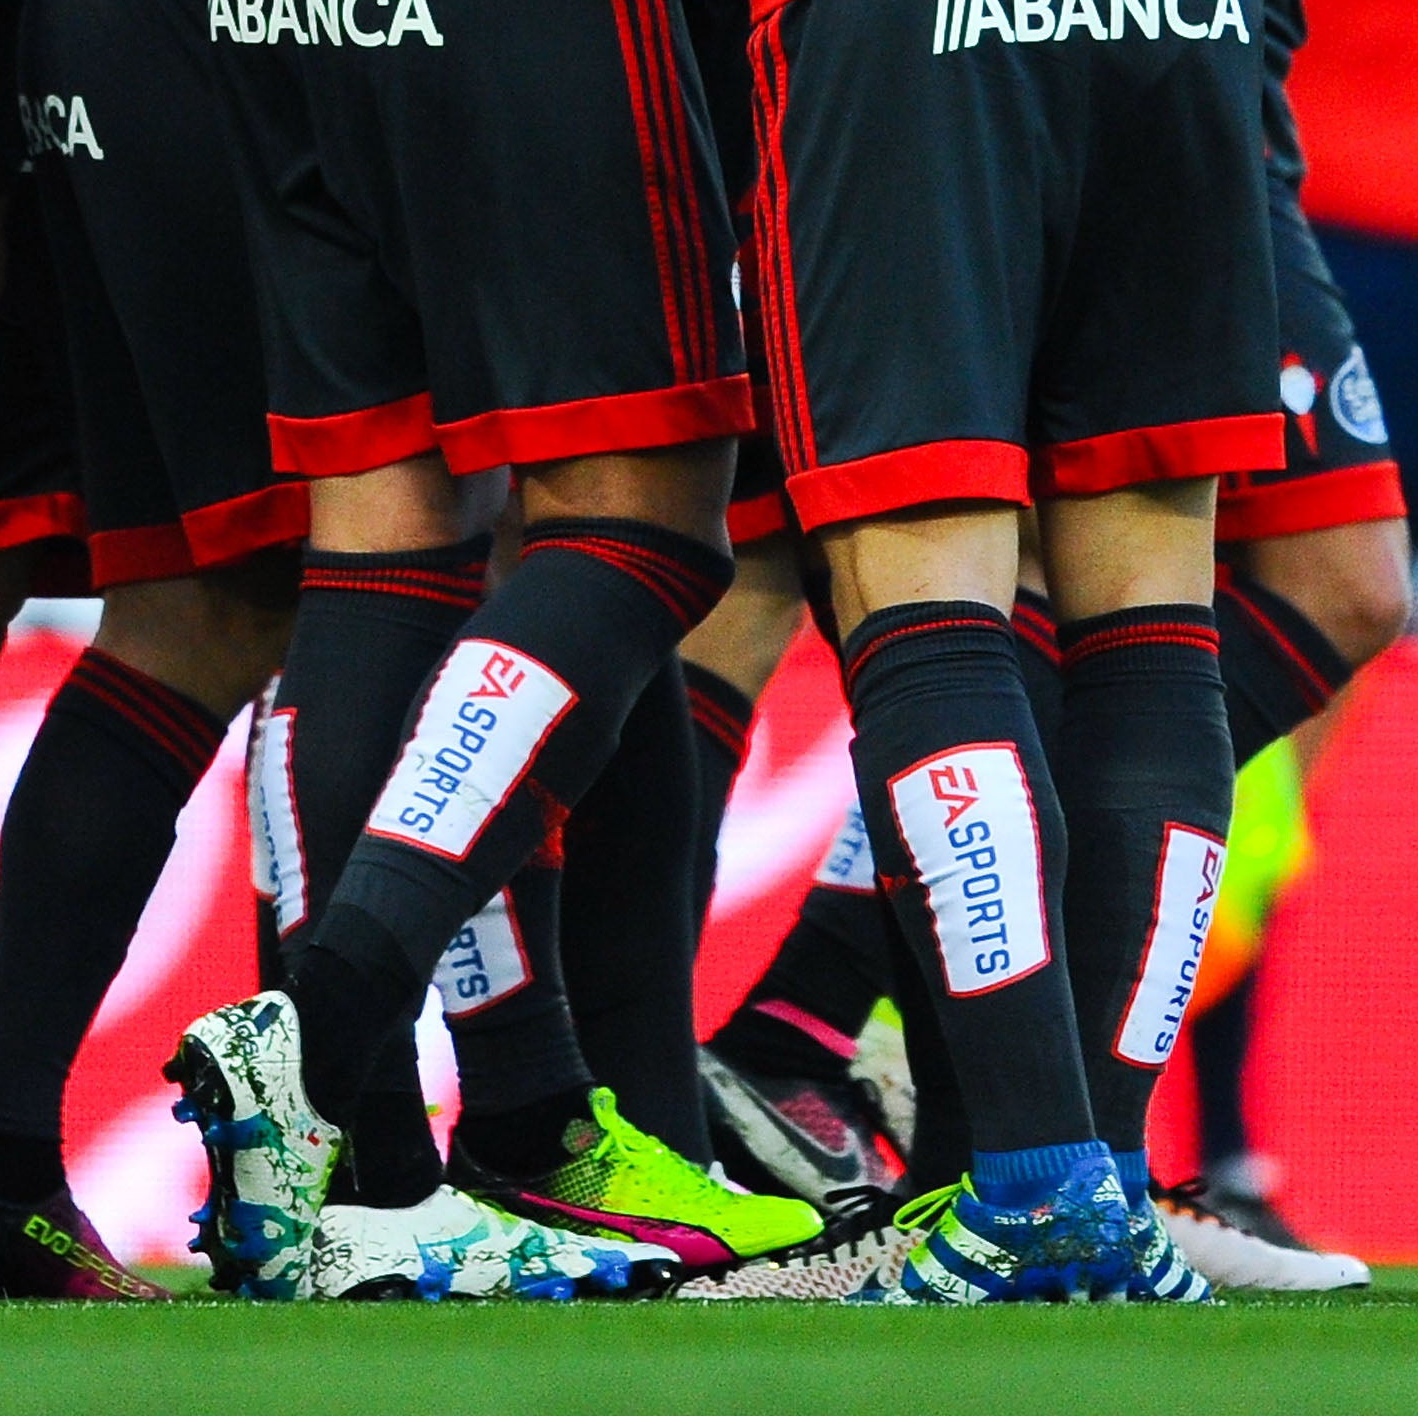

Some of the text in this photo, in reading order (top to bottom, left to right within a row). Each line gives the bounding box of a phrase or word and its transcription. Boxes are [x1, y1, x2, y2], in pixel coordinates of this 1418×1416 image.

[399, 650, 527, 835] EA SPORTS
[929, 765, 1011, 975] EA SPORTS
